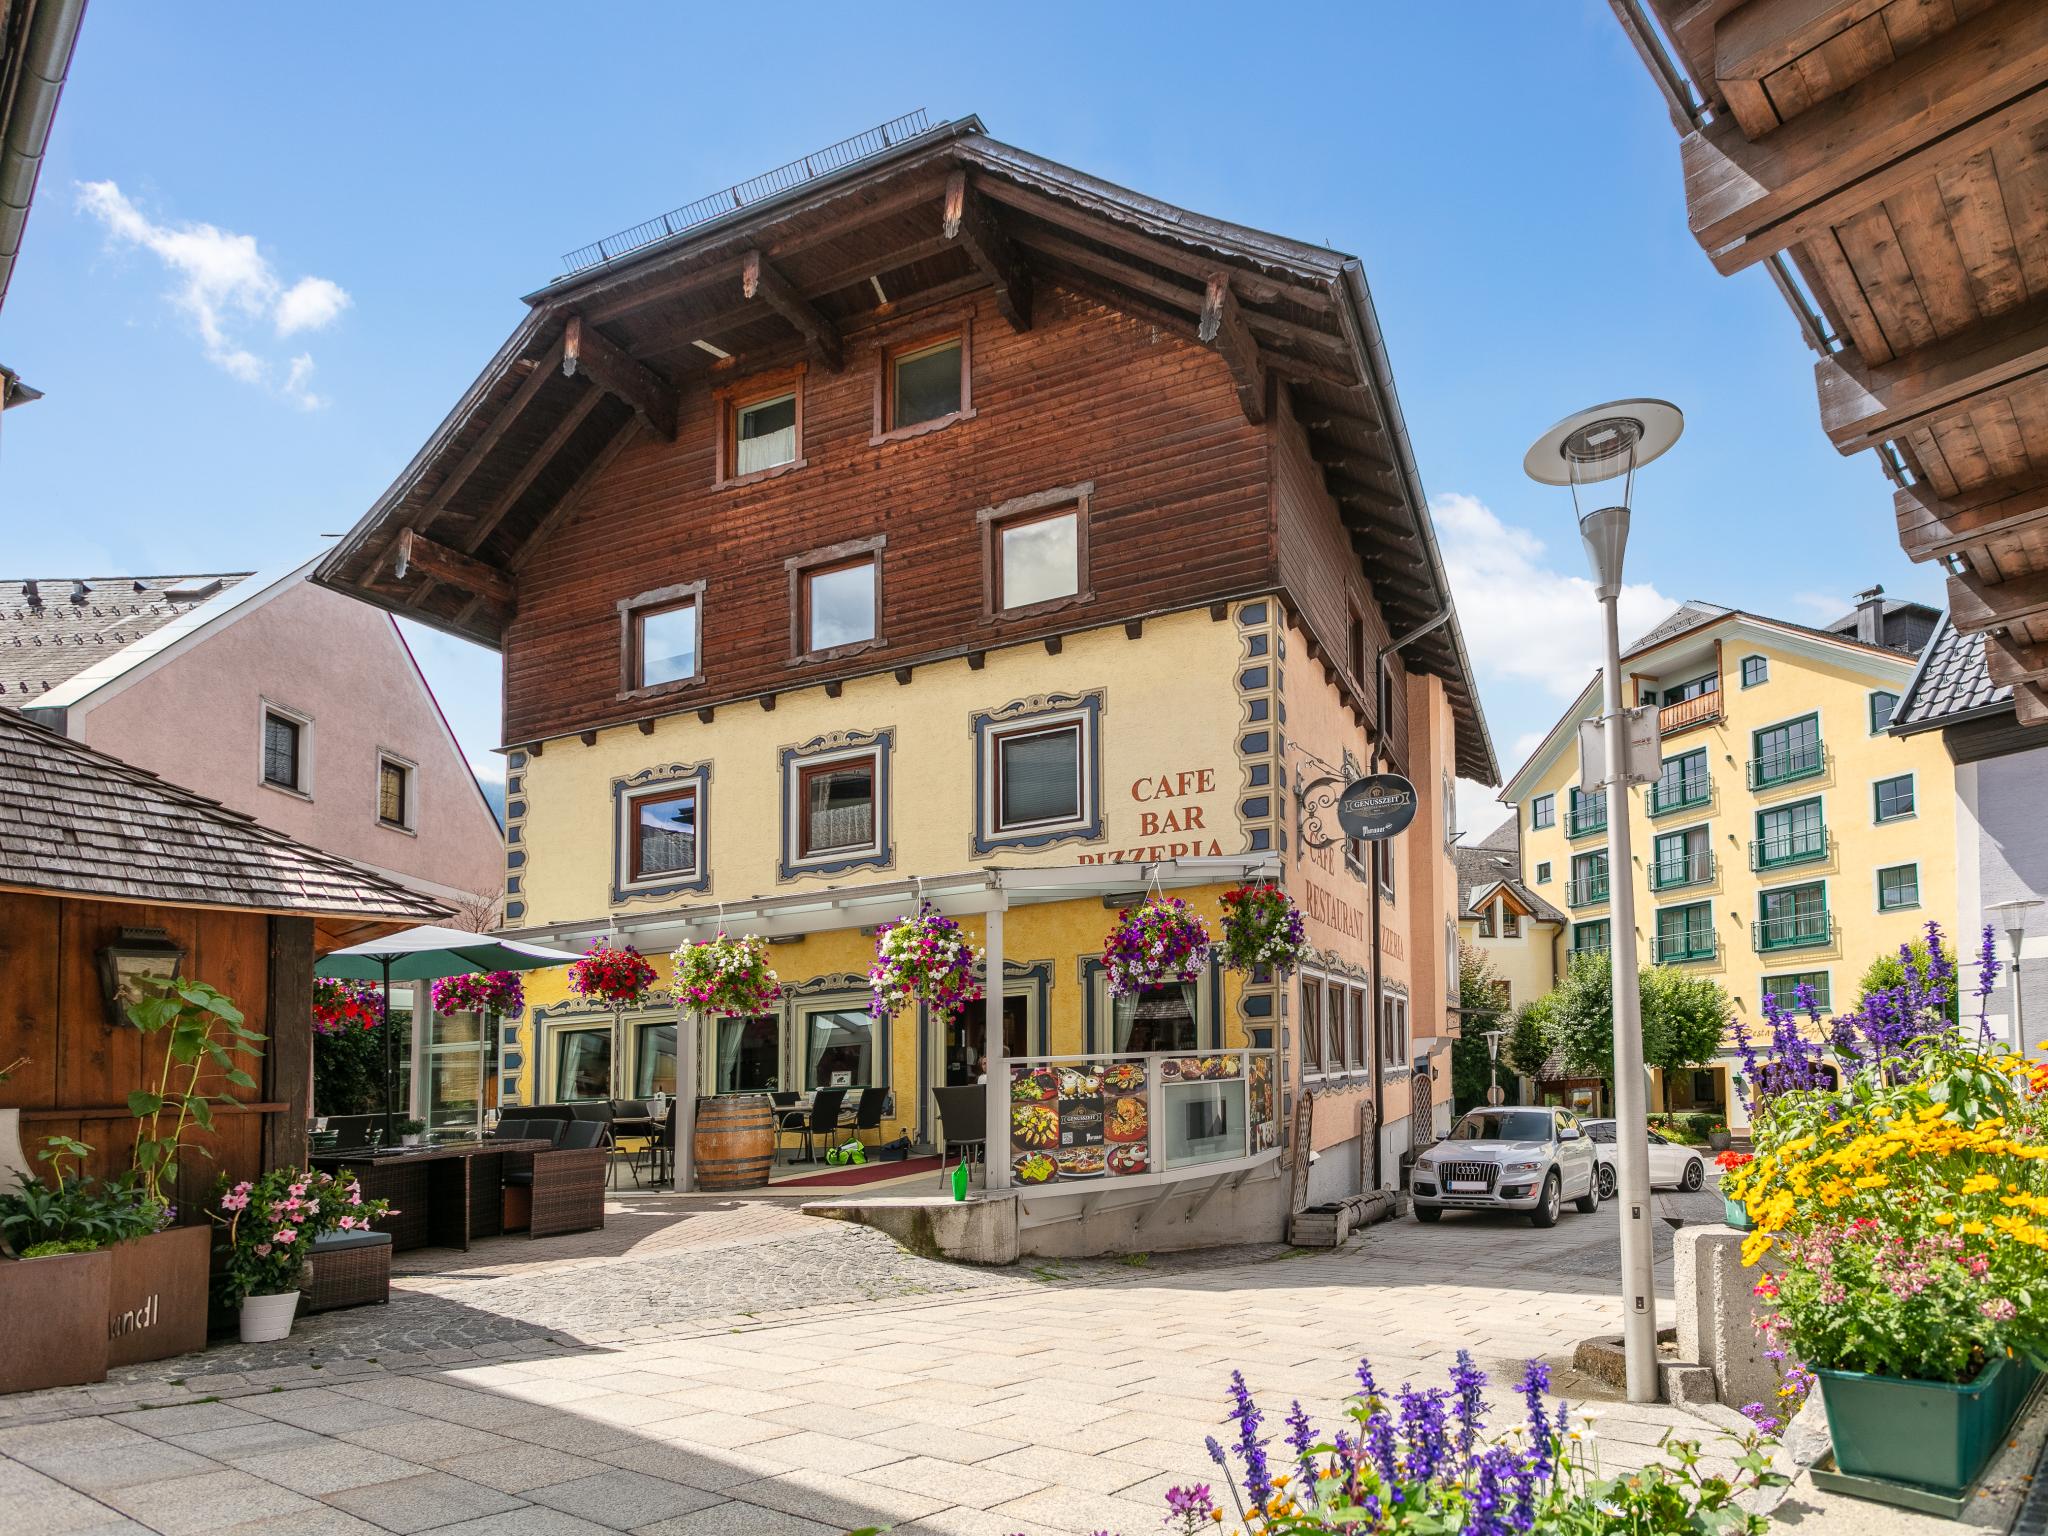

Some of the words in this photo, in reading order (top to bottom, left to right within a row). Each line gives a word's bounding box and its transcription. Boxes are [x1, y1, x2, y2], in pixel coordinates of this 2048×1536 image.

[1131, 768, 1216, 802] CAFE
[1354, 796, 1400, 808] GENUSSZEIT
[1138, 806, 1206, 836] BAR
[1309, 831, 1335, 876] CAFE
[1305, 879, 1364, 942] RESTAURANT
[1381, 924, 1404, 962] ZZERIA
